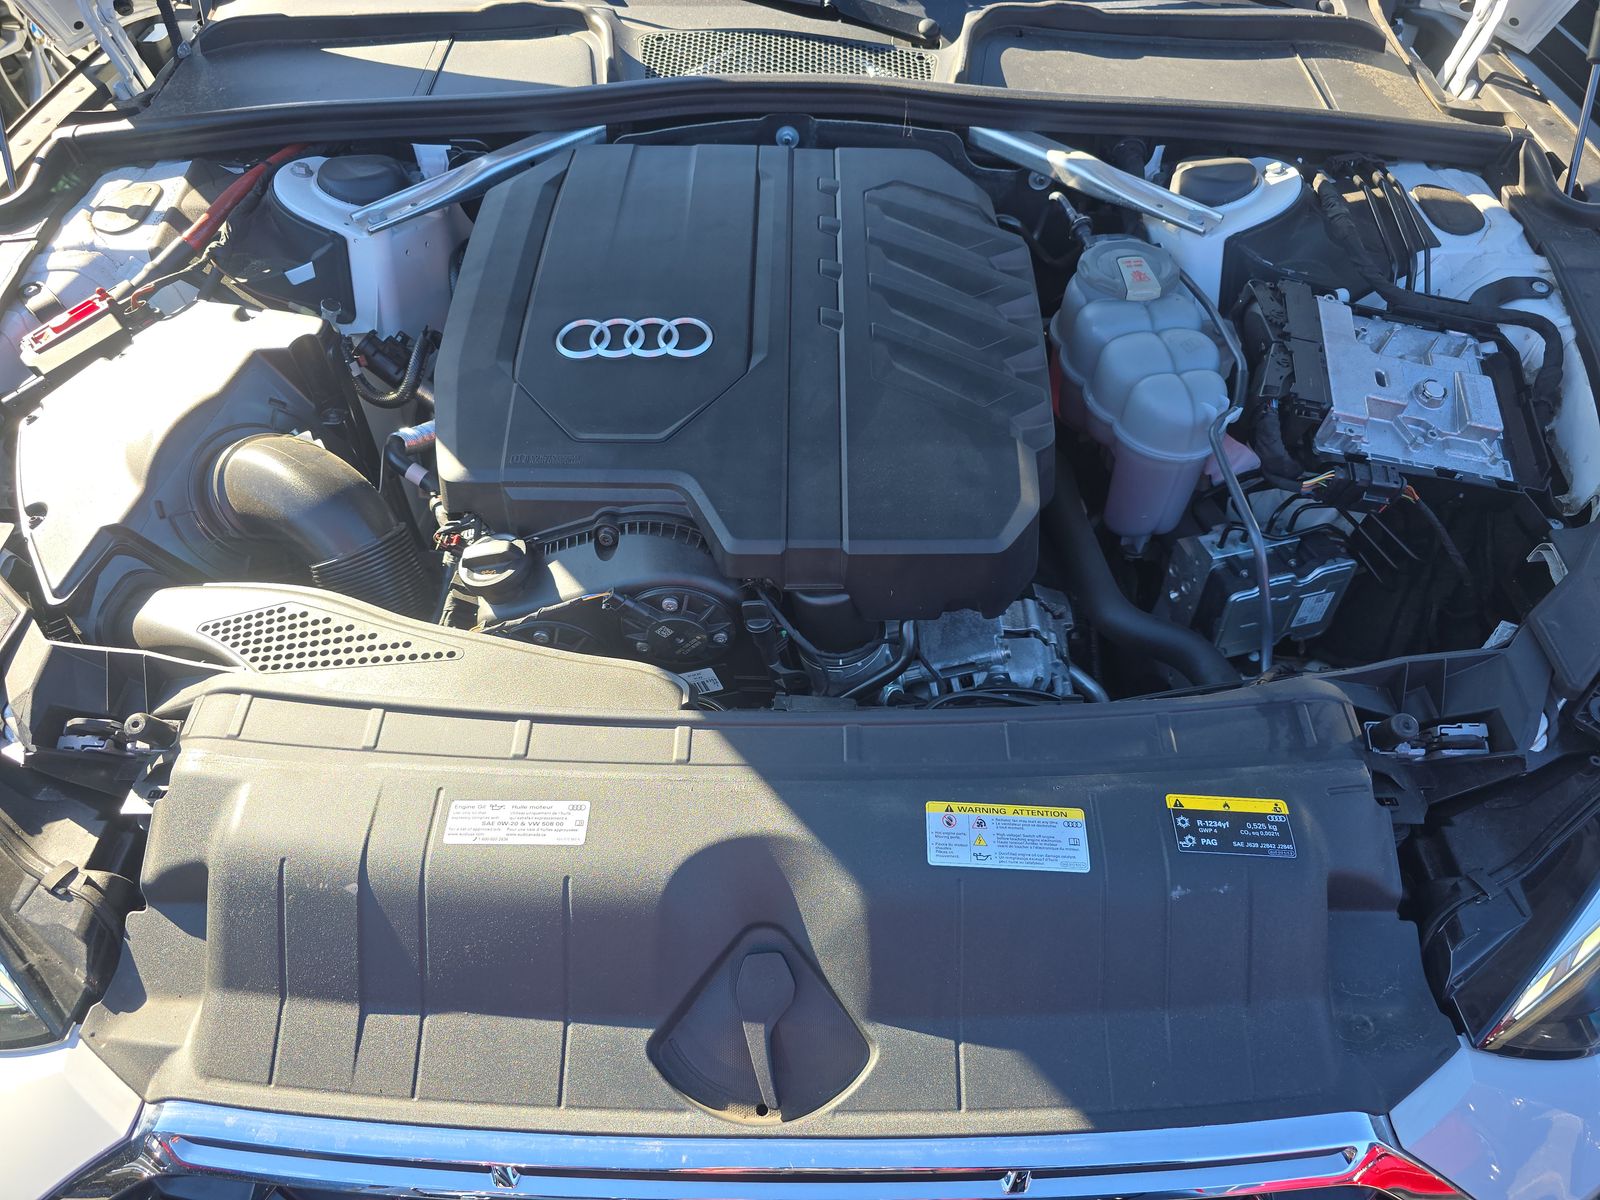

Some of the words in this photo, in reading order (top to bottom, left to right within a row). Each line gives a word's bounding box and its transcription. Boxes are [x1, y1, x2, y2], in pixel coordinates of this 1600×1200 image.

[1012, 808, 1068, 817] ATTENTION
[1196, 820, 1230, 828] R-1234yf
[1268, 823, 1278, 832] kg
